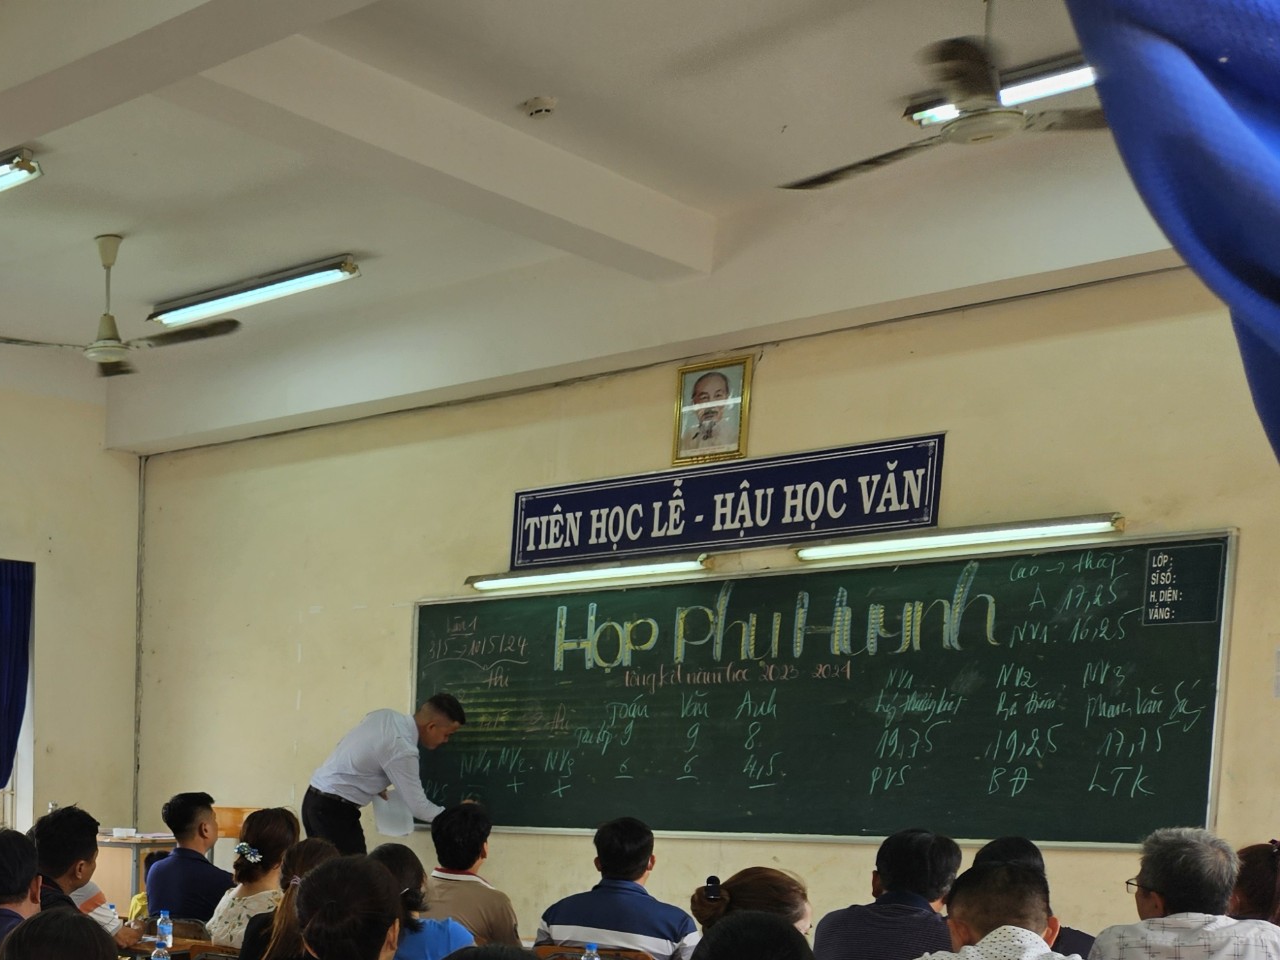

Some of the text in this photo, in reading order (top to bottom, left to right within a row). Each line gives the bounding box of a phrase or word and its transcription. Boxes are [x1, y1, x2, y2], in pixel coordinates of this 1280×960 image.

[588, 503, 643, 551] HỌC
[651, 479, 686, 538] LỄ
[712, 479, 774, 538] HẬU
[781, 478, 848, 530] HỌC
[858, 459, 926, 515] VĂN
[554, 602, 659, 674] Họp
[759, 663, 800, 682] 2023
[811, 659, 852, 681] 2024
[744, 721, 761, 750] 8
